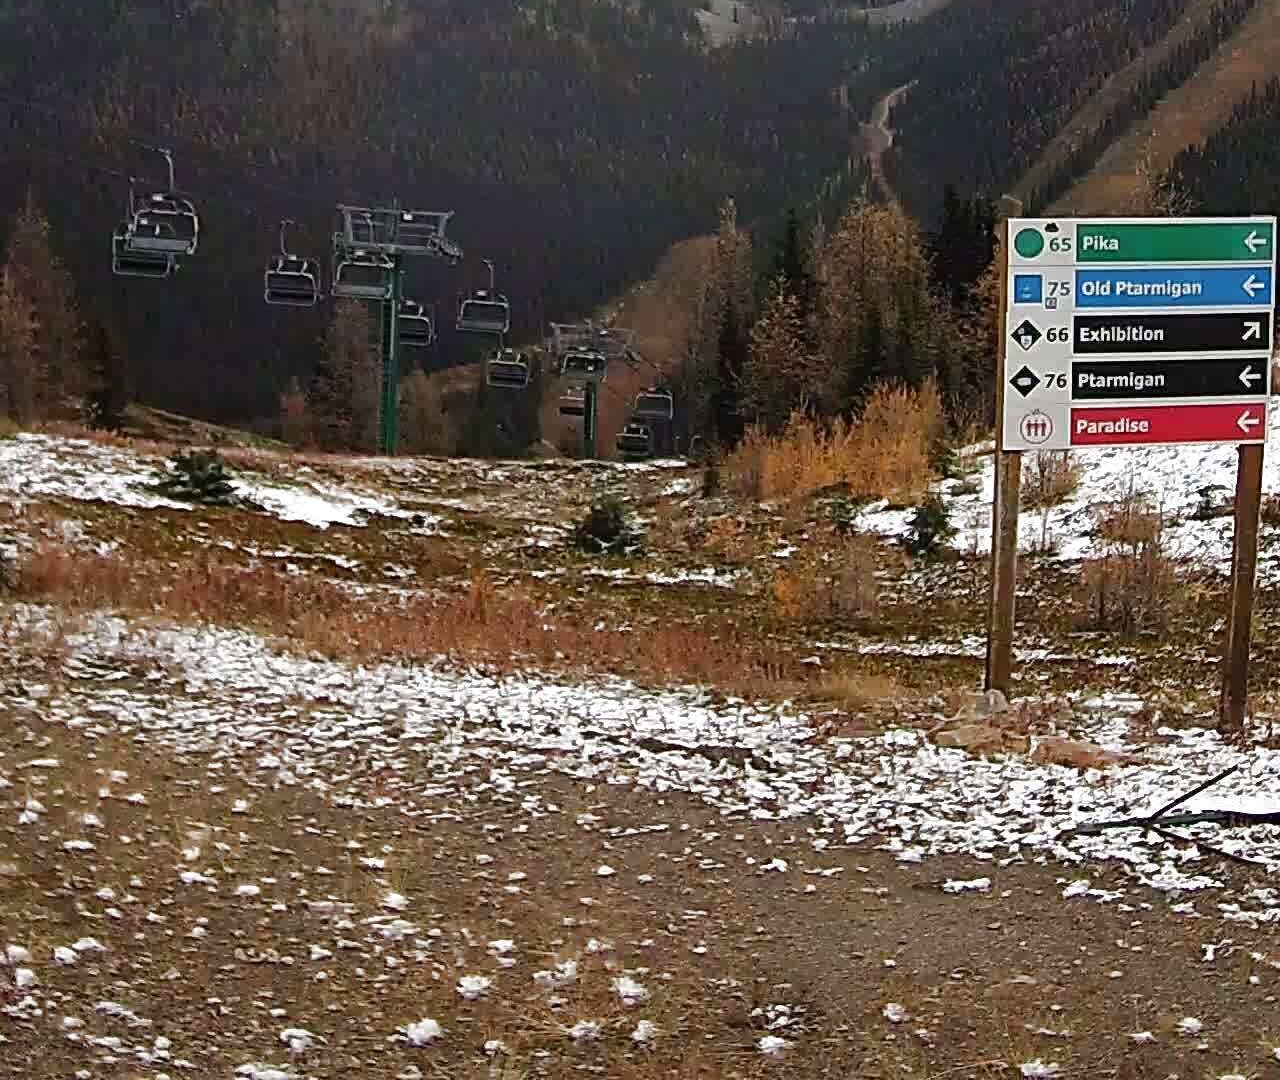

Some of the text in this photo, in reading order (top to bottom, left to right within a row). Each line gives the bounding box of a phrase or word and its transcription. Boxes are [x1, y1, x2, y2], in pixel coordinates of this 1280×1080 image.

[1049, 236, 1119, 252] 65 Pika
[1048, 280, 1202, 297] 75 Old Ptarmigan
[1046, 326, 1164, 342] 66 Exhibition
[1044, 372, 1165, 390] 76 Ptarmigan
[1076, 418, 1149, 434] Paradise
